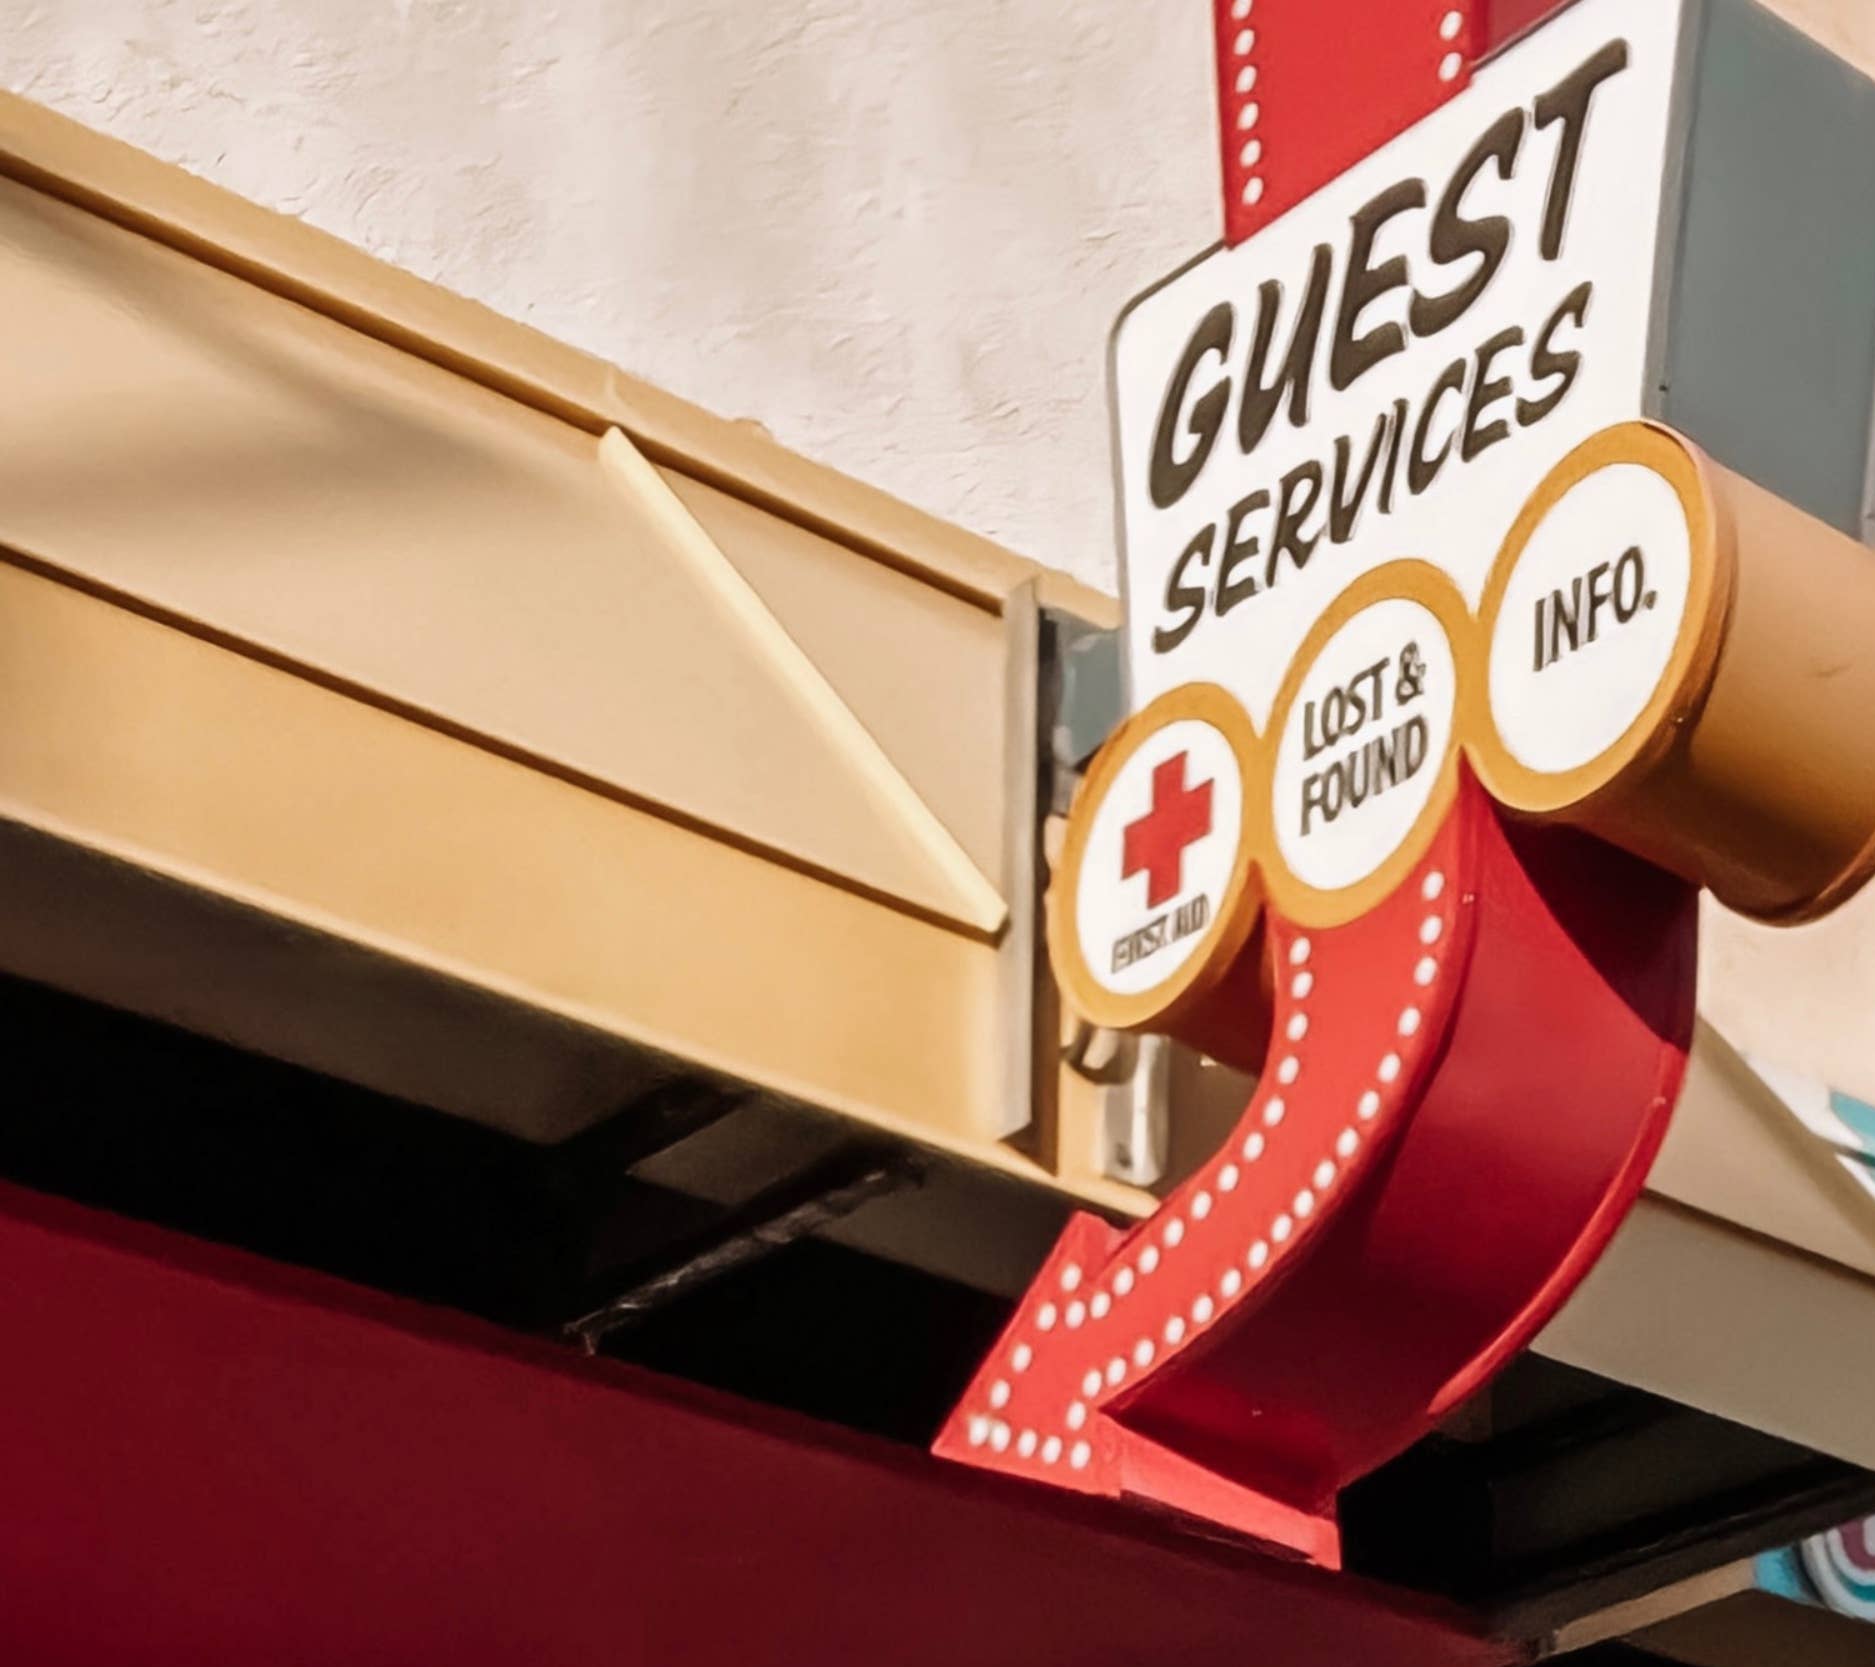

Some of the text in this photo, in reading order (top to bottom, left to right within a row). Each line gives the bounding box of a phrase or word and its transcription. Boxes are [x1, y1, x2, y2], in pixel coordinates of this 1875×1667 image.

[1147, 37, 1630, 511] GUEST
[1150, 280, 1594, 655] SERVICES
[1532, 545, 1659, 673] INFO.
[1303, 640, 1428, 762] LOST &
[1300, 713, 1429, 838] FOUND
